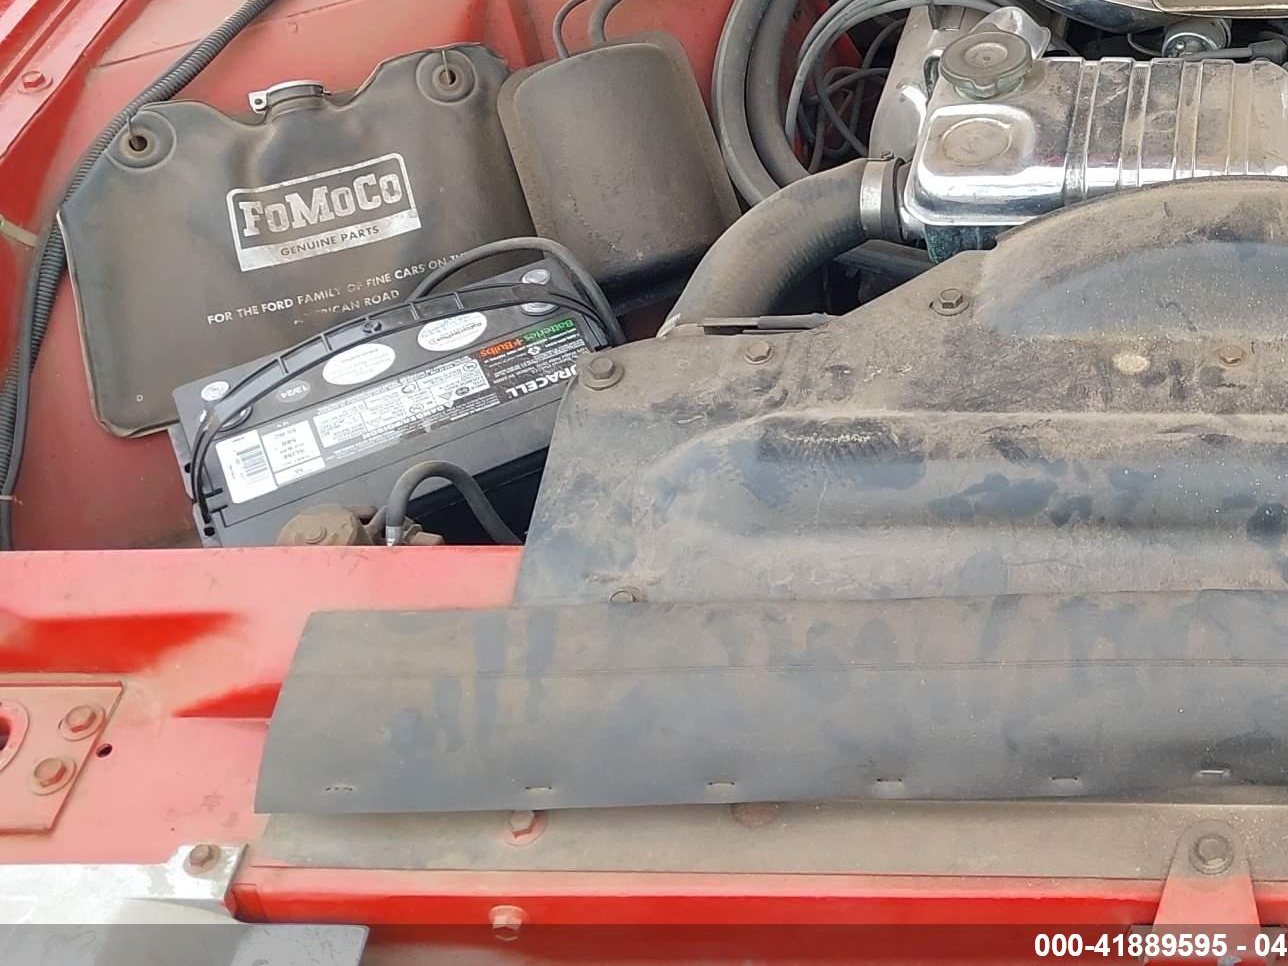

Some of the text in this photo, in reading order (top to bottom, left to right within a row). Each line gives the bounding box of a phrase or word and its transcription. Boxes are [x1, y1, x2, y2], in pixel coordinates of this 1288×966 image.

[239, 173, 402, 237] FoMoCo
[280, 225, 380, 256] GENUINE PARTS
[207, 311, 233, 325] FOR
[236, 305, 260, 318] THE
[261, 298, 293, 313] FORD
[366, 273, 392, 287] FINE
[394, 263, 425, 280] CARS
[428, 257, 447, 270] ON
[363, 289, 400, 307] ROAD
[280, 383, 307, 399] 12/24
[506, 364, 578, 398] URACELL
